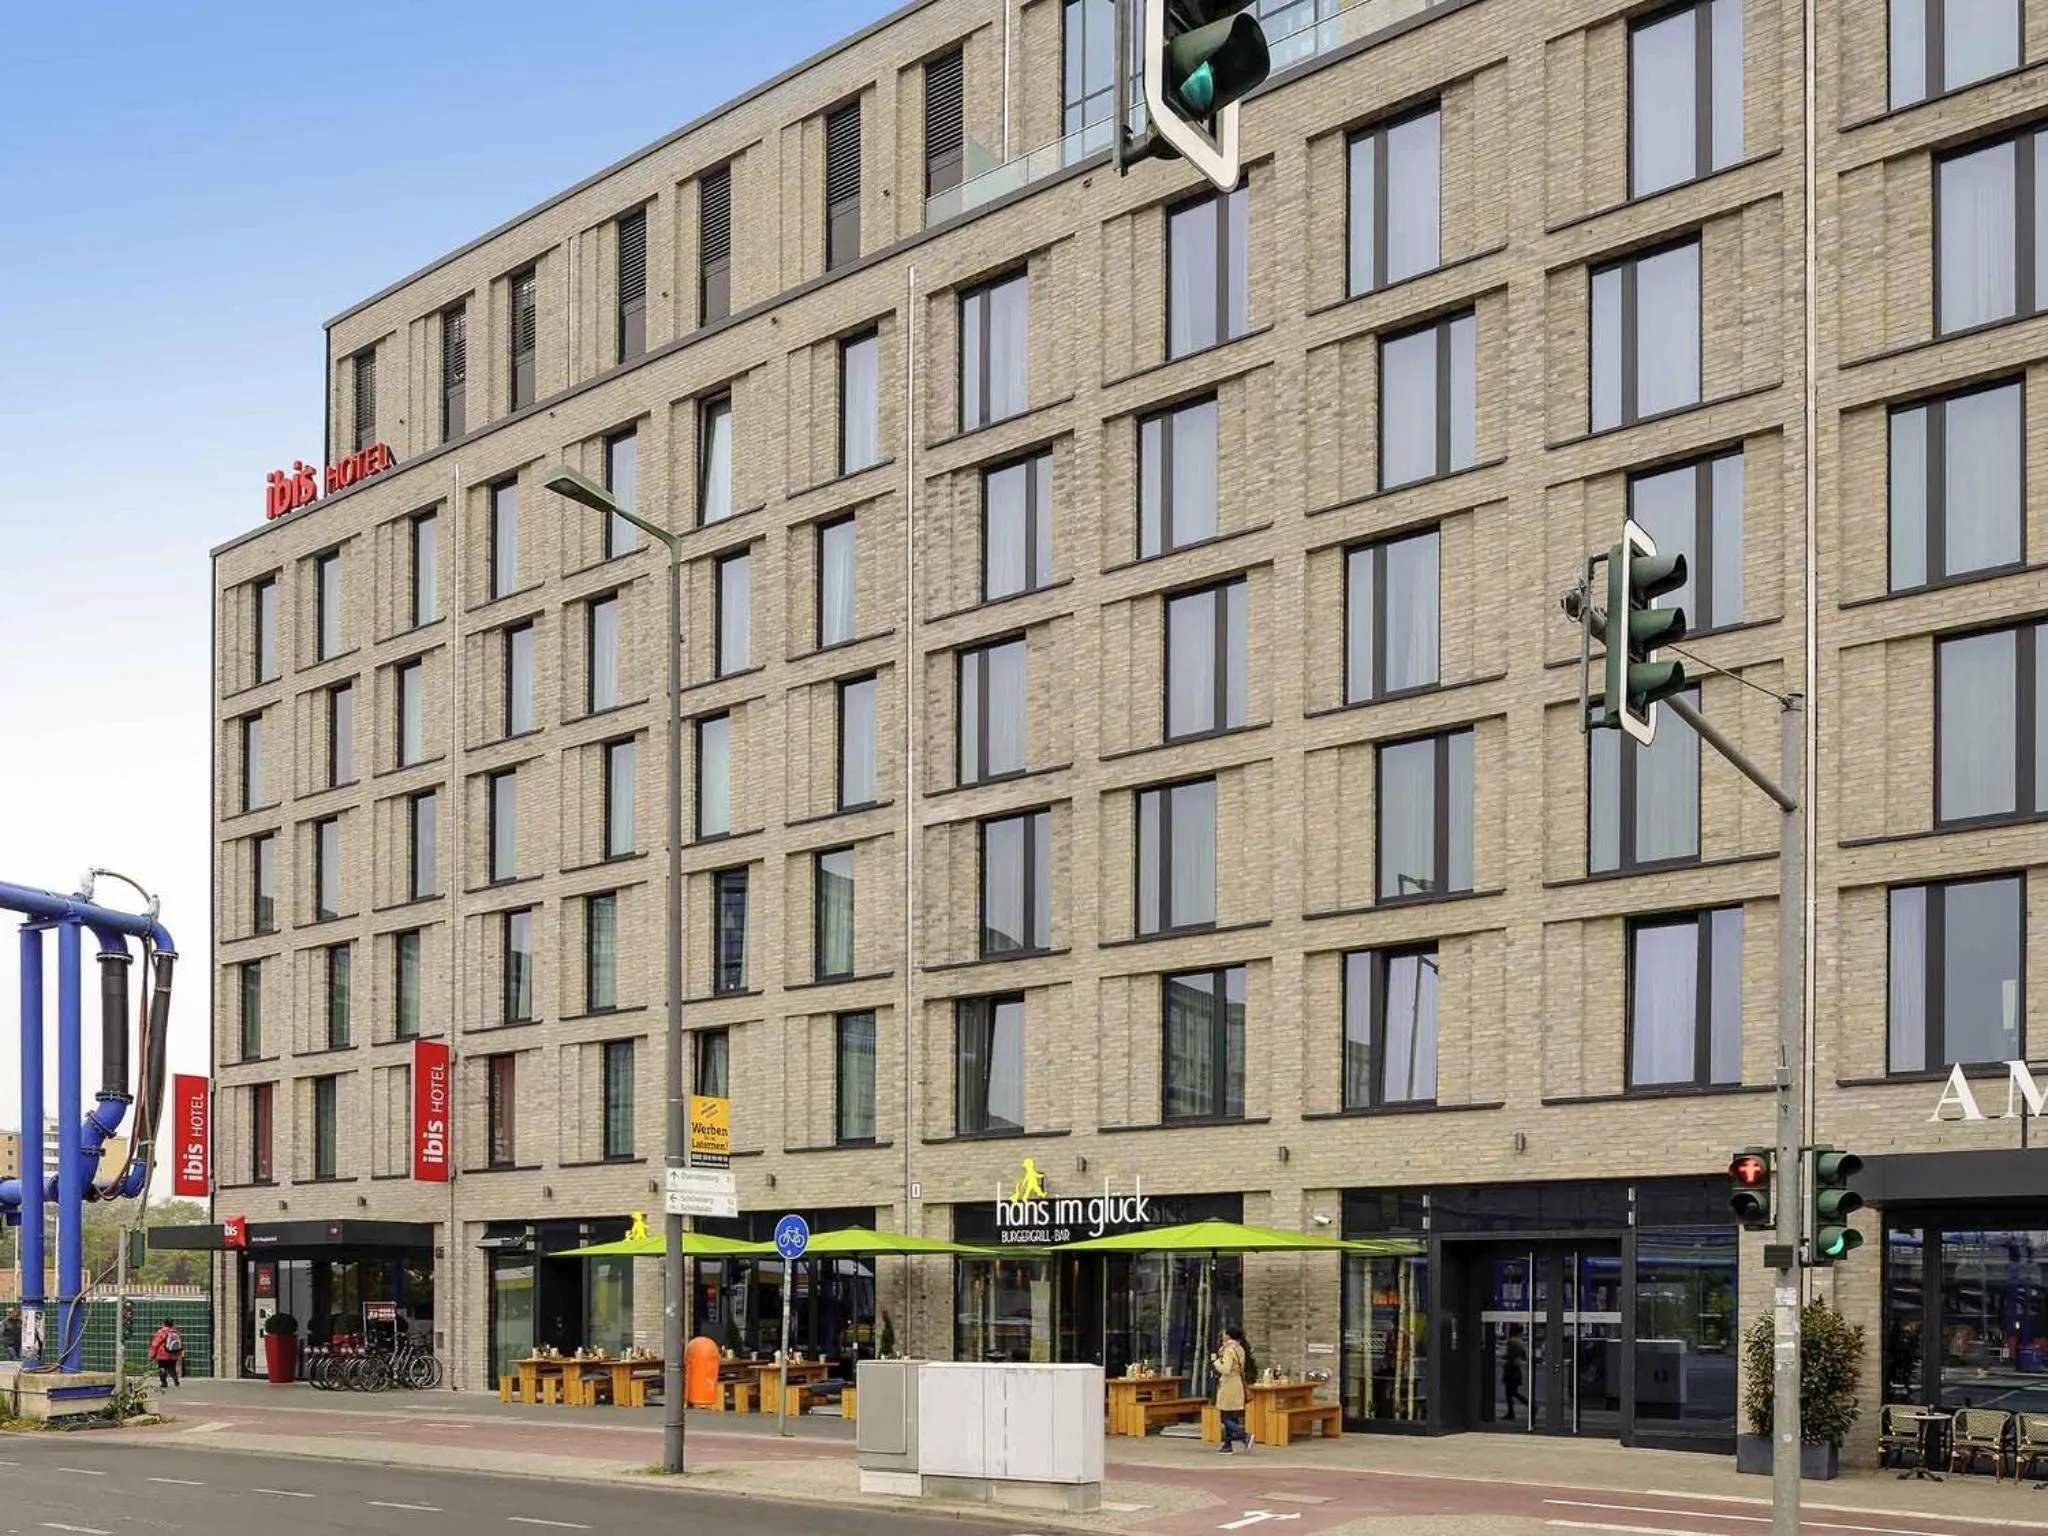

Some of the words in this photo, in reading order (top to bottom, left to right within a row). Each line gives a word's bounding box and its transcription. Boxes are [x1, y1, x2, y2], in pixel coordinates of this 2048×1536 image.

[266, 459, 317, 520] ibis
[325, 443, 397, 494] HOTEL
[430, 1062, 445, 1113] HOTEL
[190, 1092, 205, 1137] HOTEL
[691, 1121, 729, 1137] Werben
[183, 1143, 204, 1182] ibis
[423, 1120, 444, 1164] ibis
[996, 1181, 1050, 1226] hans
[1055, 1194, 1083, 1225] im
[1088, 1175, 1150, 1237] glück
[224, 1223, 238, 1237] bis
